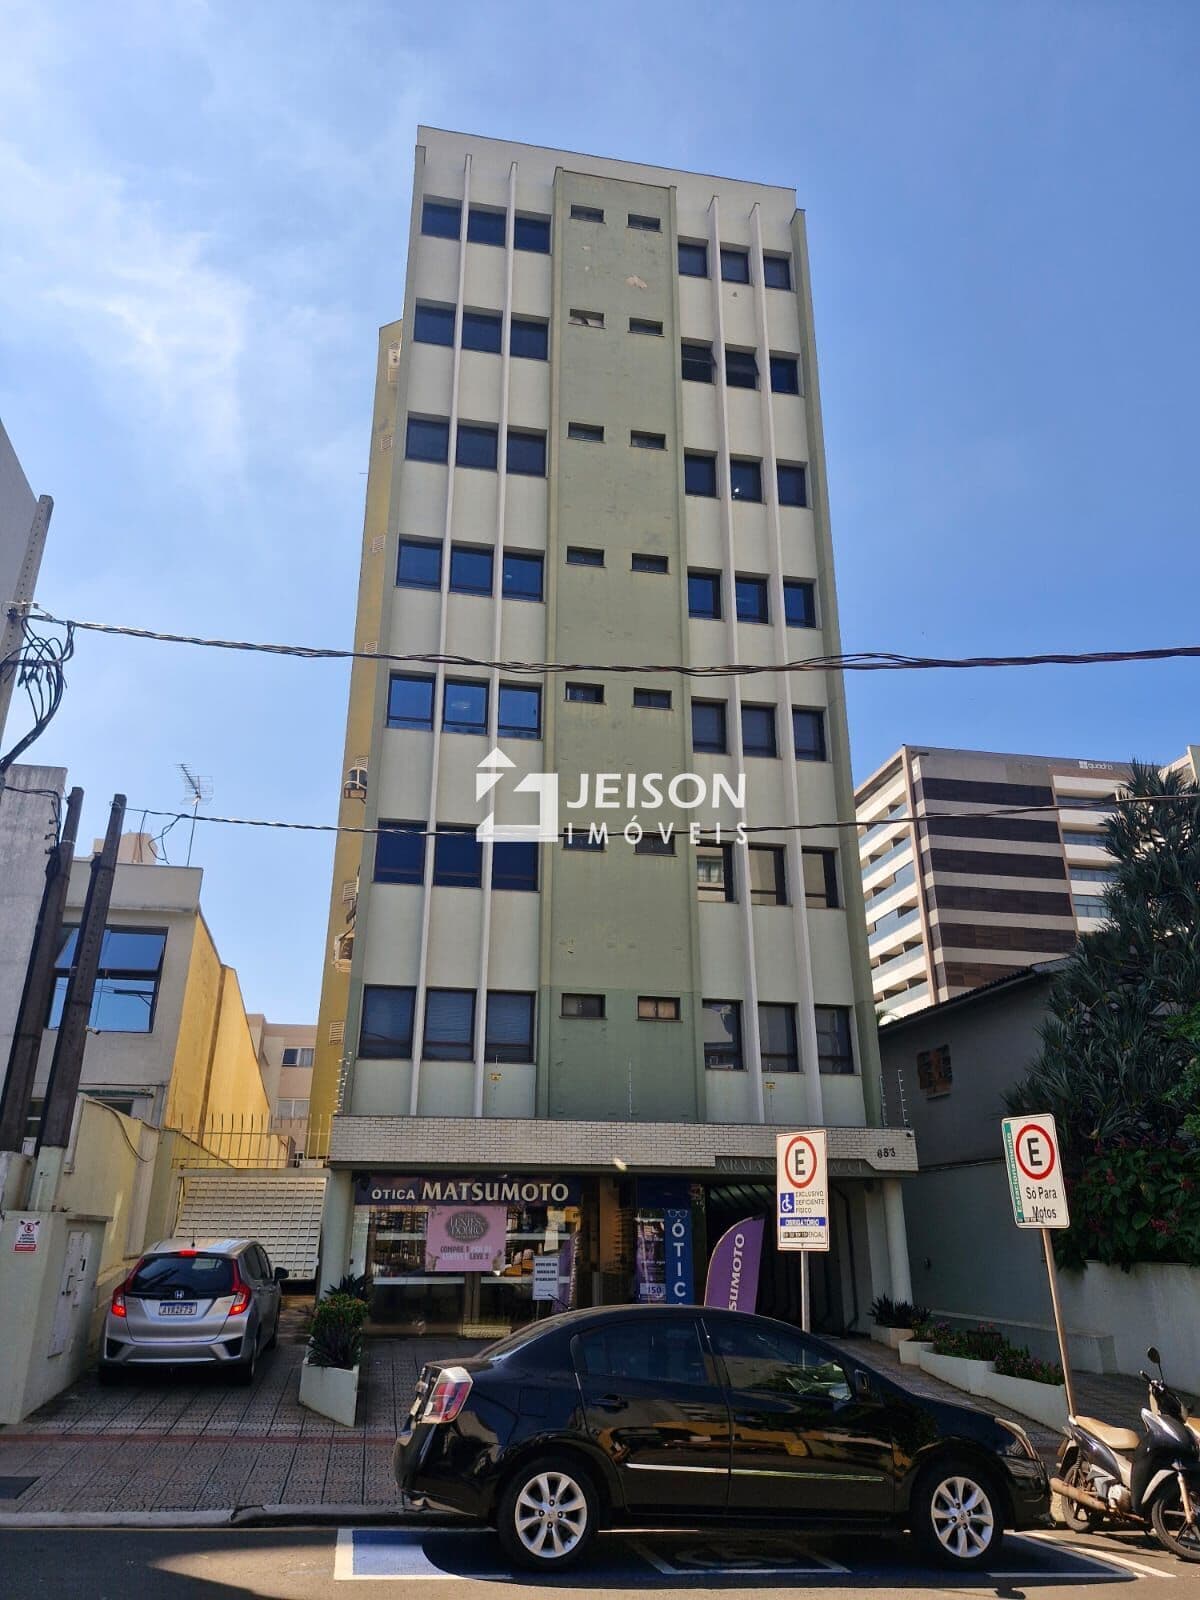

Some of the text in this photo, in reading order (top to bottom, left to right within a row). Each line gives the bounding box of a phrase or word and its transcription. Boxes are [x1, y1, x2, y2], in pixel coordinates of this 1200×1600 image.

[795, 1148, 806, 1176] E
[1027, 1137, 1043, 1166] E
[371, 1182, 569, 1202] ÓTICA MATSUMOTO
[1026, 1186, 1057, 1200] Só Para
[1032, 1206, 1057, 1218] Motos
[440, 1245, 464, 1253] COMPRE
[671, 1219, 687, 1305] ÓTIC
[728, 1233, 745, 1311] SUMOTO
